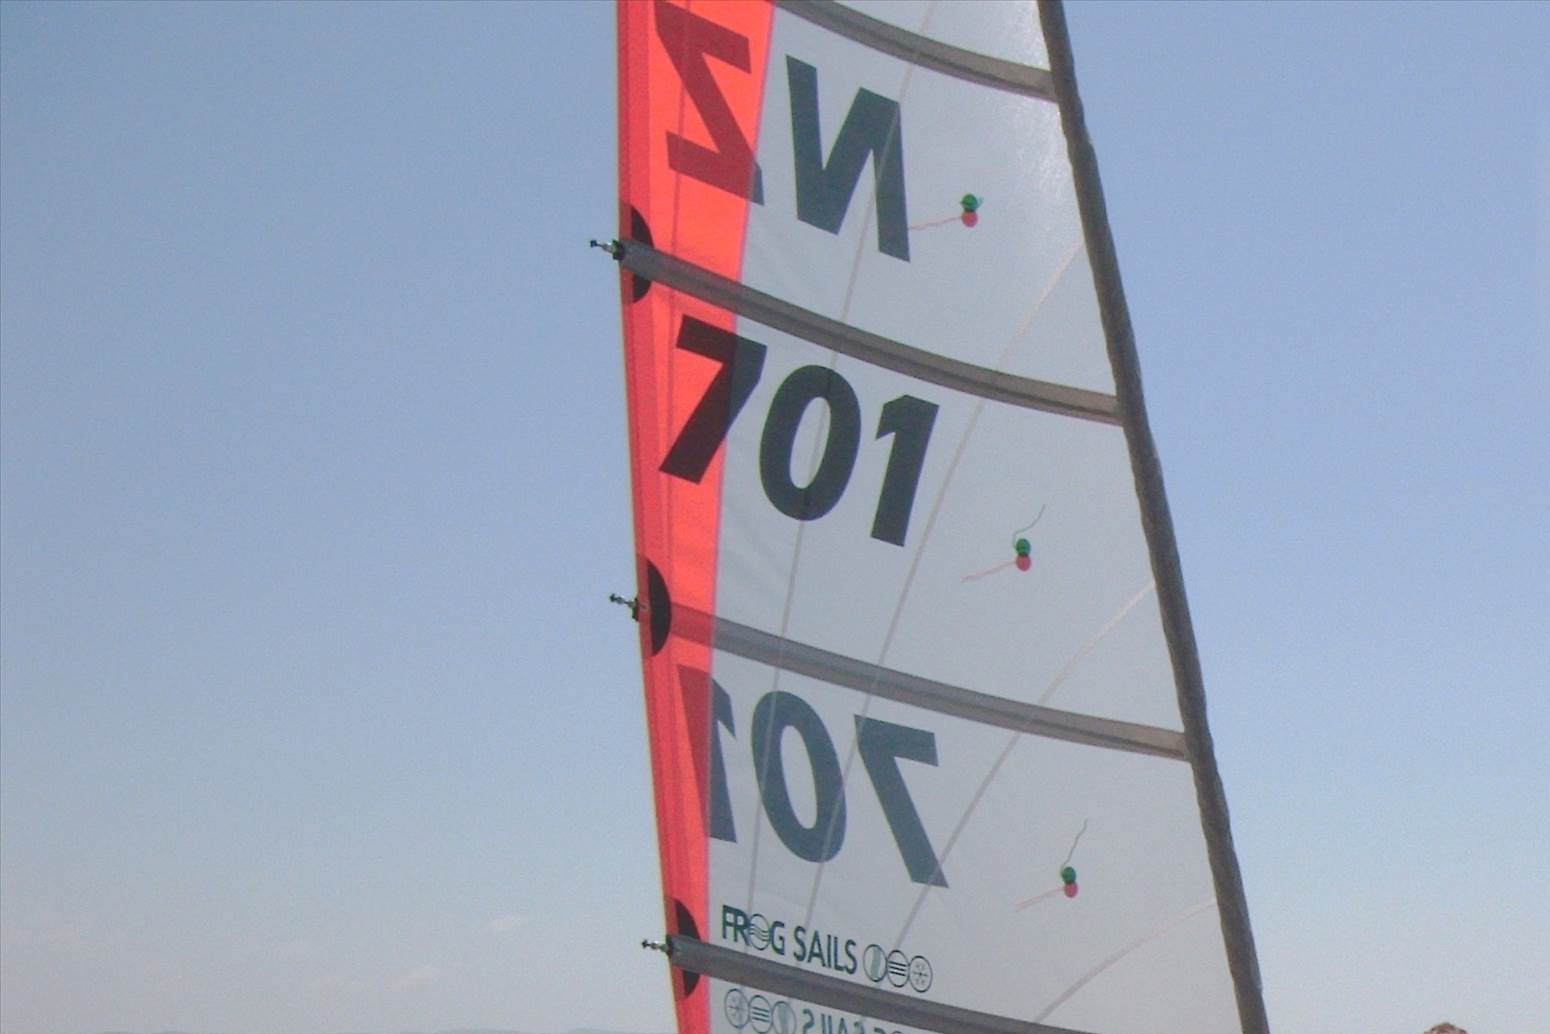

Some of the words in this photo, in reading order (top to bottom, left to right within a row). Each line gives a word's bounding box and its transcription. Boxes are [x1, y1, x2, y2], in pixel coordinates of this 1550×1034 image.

[658, 314, 940, 548] 701
[722, 904, 786, 956] FROG
[793, 925, 858, 975] SAILS
